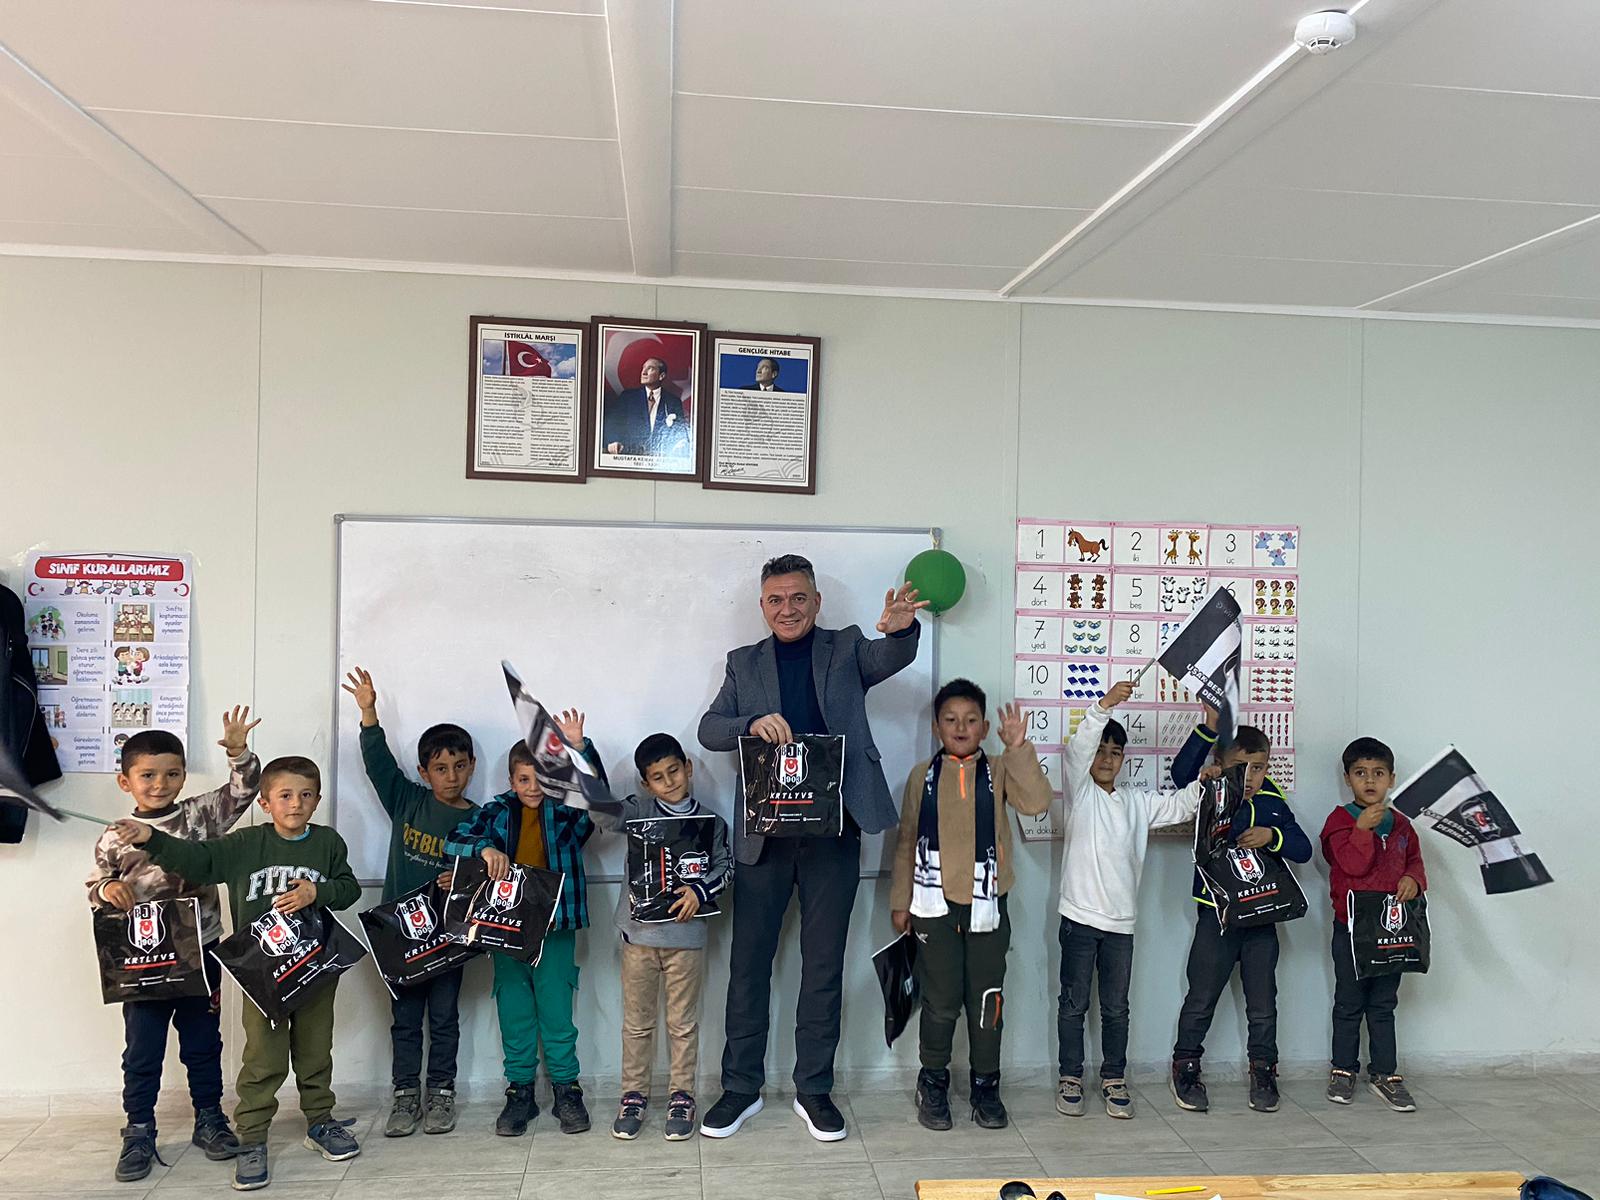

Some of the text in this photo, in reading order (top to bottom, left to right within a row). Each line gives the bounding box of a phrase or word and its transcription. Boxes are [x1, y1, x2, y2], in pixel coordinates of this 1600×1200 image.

[504, 332, 533, 340] İSTİKLÂL
[738, 347, 767, 355] GENÇLİĞE
[1037, 529, 1044, 548] 1
[1131, 531, 1142, 550] 2
[1225, 533, 1236, 552] 3
[1035, 551, 1046, 560] bir
[48, 563, 170, 576] SINIF KURALLARIMIZ
[1033, 576, 1047, 594] 4
[1132, 578, 1143, 598] 5
[1226, 581, 1236, 598] 6
[1130, 601, 1142, 610] beş
[1034, 620, 1045, 639] 7
[1129, 624, 1140, 642] 8
[1031, 642, 1046, 652] yedi
[1126, 646, 1142, 655] sekiz
[1028, 665, 1048, 684] 10
[1134, 690, 1144, 699] bir
[1028, 710, 1048, 730] 13
[1122, 713, 1146, 732] 14
[1132, 736, 1148, 744] dört
[781, 746, 802, 756] BJK
[1125, 758, 1144, 778] 17
[1238, 882, 1277, 898] KRTLYVS
[472, 911, 522, 927] KRTLYVS
[404, 934, 448, 959] KRTLYV
[1378, 936, 1414, 944] KRTLYVS
[124, 952, 176, 964] KRTLYVS
